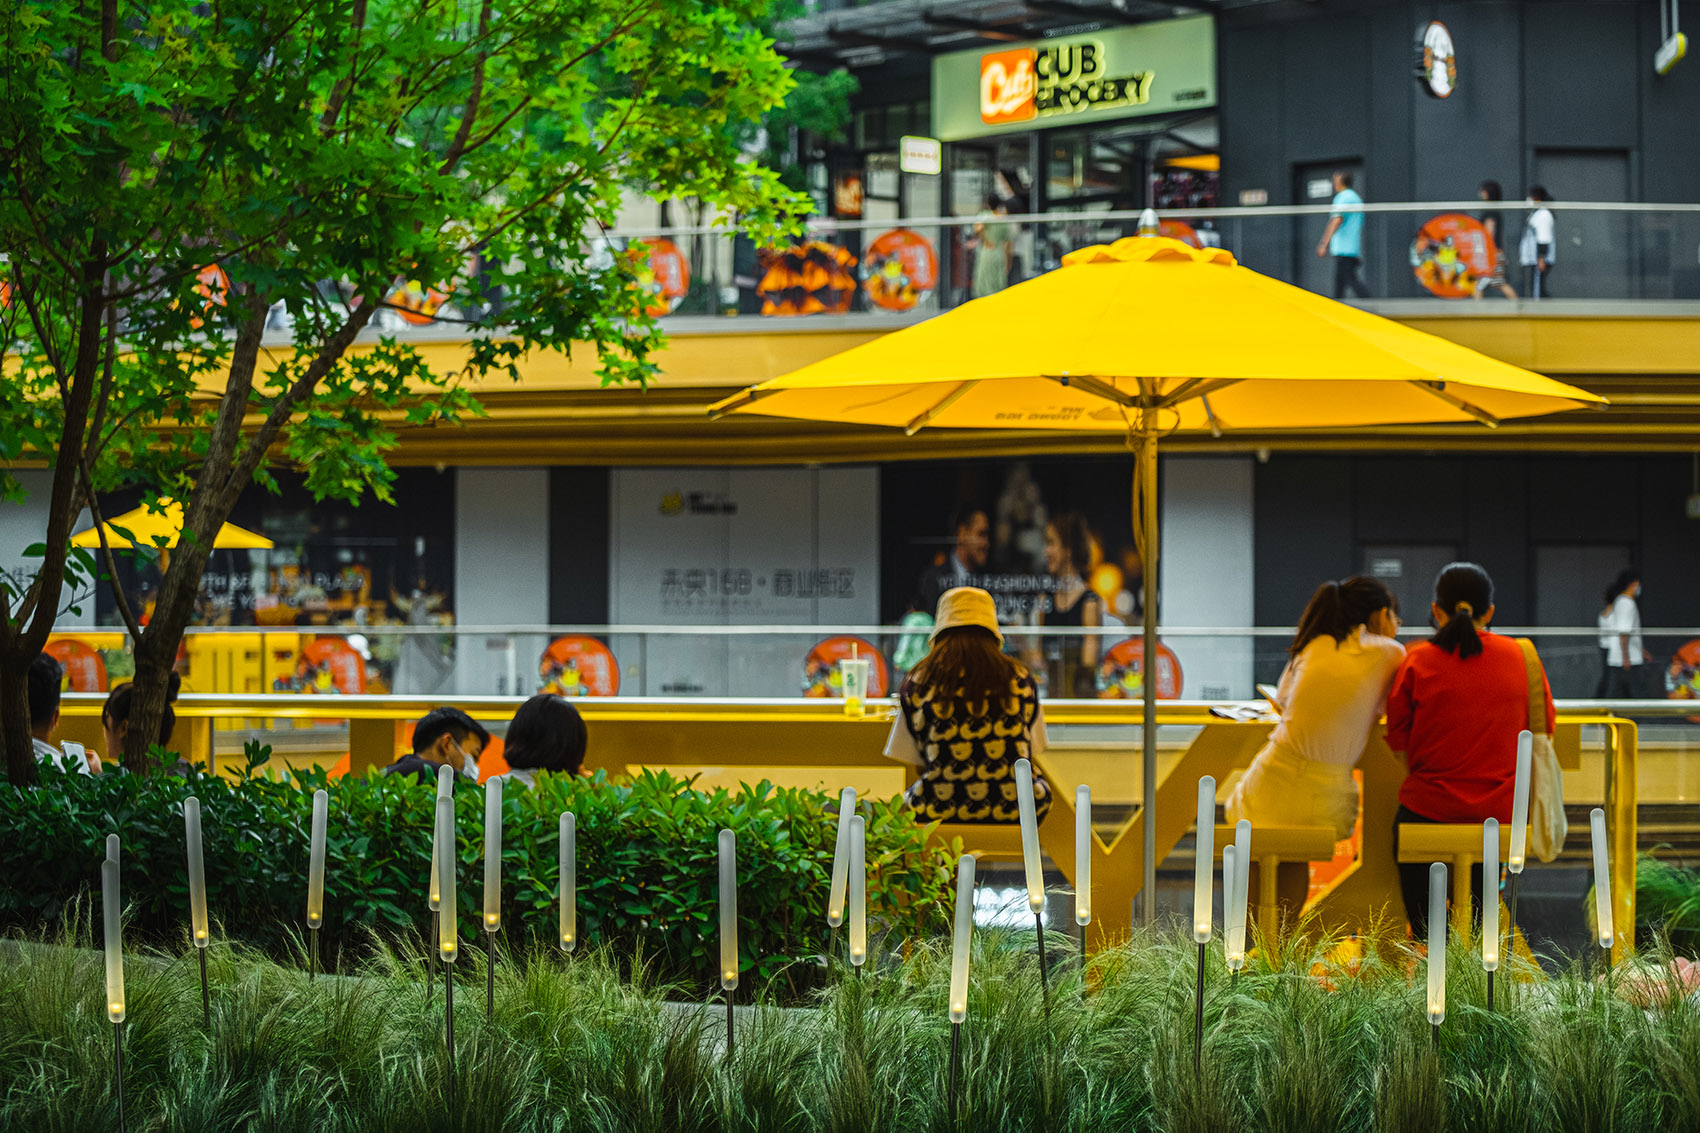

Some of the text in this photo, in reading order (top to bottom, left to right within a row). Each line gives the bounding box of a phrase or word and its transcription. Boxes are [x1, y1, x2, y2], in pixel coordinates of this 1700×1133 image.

[1035, 42, 1106, 86] CUB
[980, 60, 1034, 117] Cub
[1035, 70, 1155, 117] GROCERY
